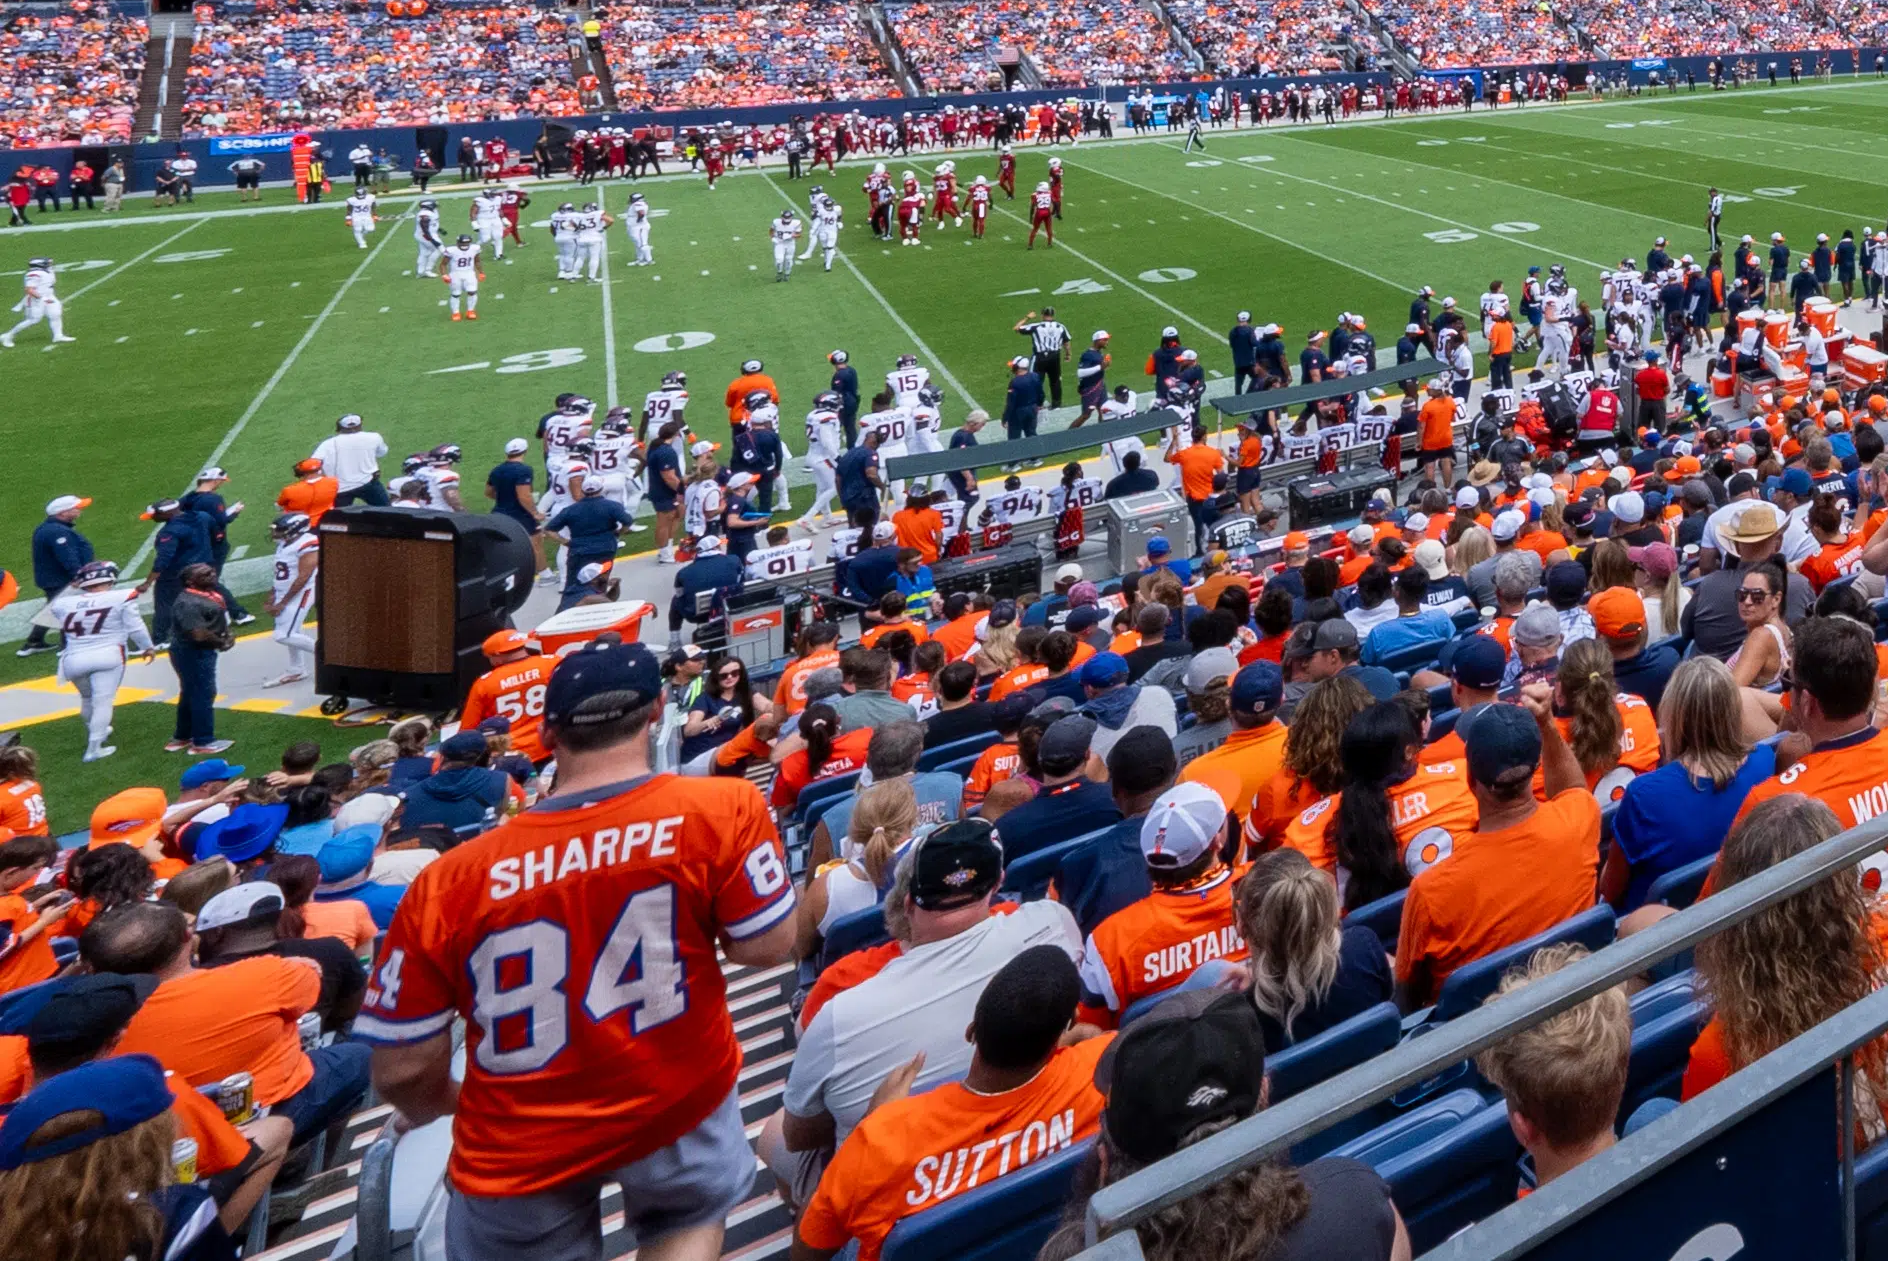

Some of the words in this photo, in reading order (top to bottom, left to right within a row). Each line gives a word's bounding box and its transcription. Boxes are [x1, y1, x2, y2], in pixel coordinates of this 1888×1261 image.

[577, 218, 597, 231] 63
[1421, 220, 1543, 244] 50
[896, 374, 918, 393] 15
[1325, 433, 1351, 451] 57
[1360, 422, 1386, 441] 50
[593, 449, 618, 472] 13
[1002, 493, 1034, 516] 94
[767, 555, 796, 576] 91
[1427, 588, 1454, 606] ELWAY
[63, 605, 113, 638] 47
[500, 668, 541, 692] MILLER
[495, 683, 547, 724] 58
[489, 815, 685, 901] SHARPE
[744, 840, 786, 897] 8
[1142, 925, 1247, 985] SURTAIN
[467, 882, 691, 1077] 84
[905, 1108, 1075, 1207] SUTTON
